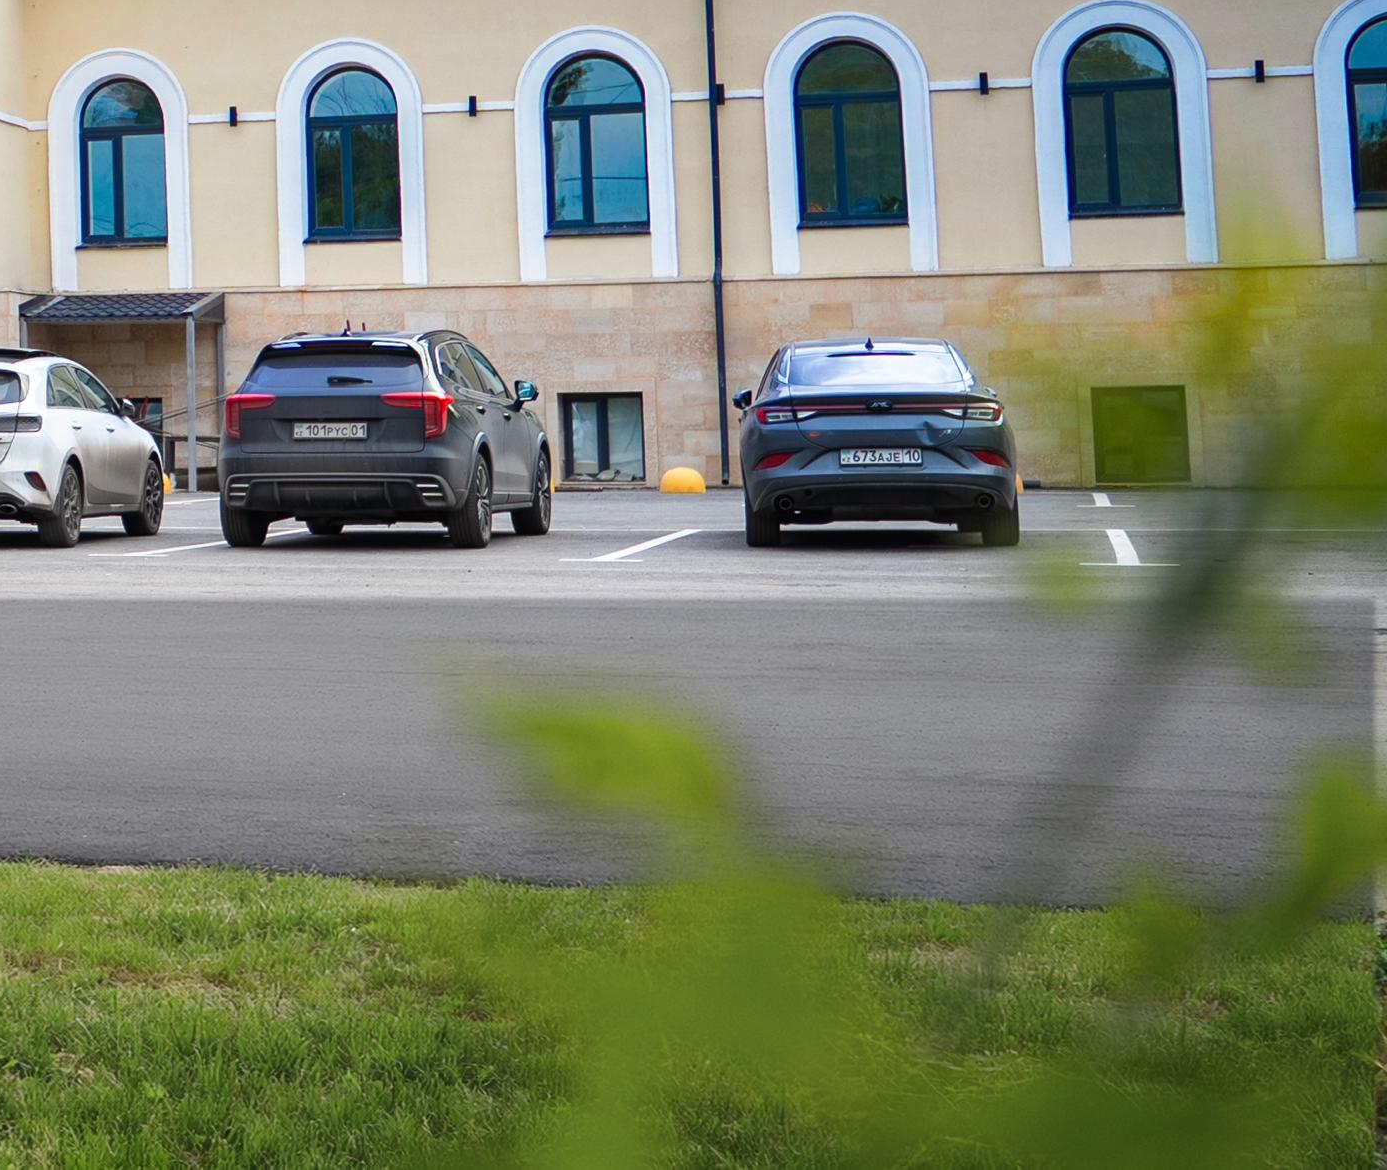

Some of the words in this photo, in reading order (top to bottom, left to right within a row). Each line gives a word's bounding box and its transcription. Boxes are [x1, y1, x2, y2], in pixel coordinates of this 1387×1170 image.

[306, 424, 348, 436] 101PYC
[351, 424, 366, 436] 01
[852, 450, 901, 462] 673AJE
[905, 449, 921, 462] 10
